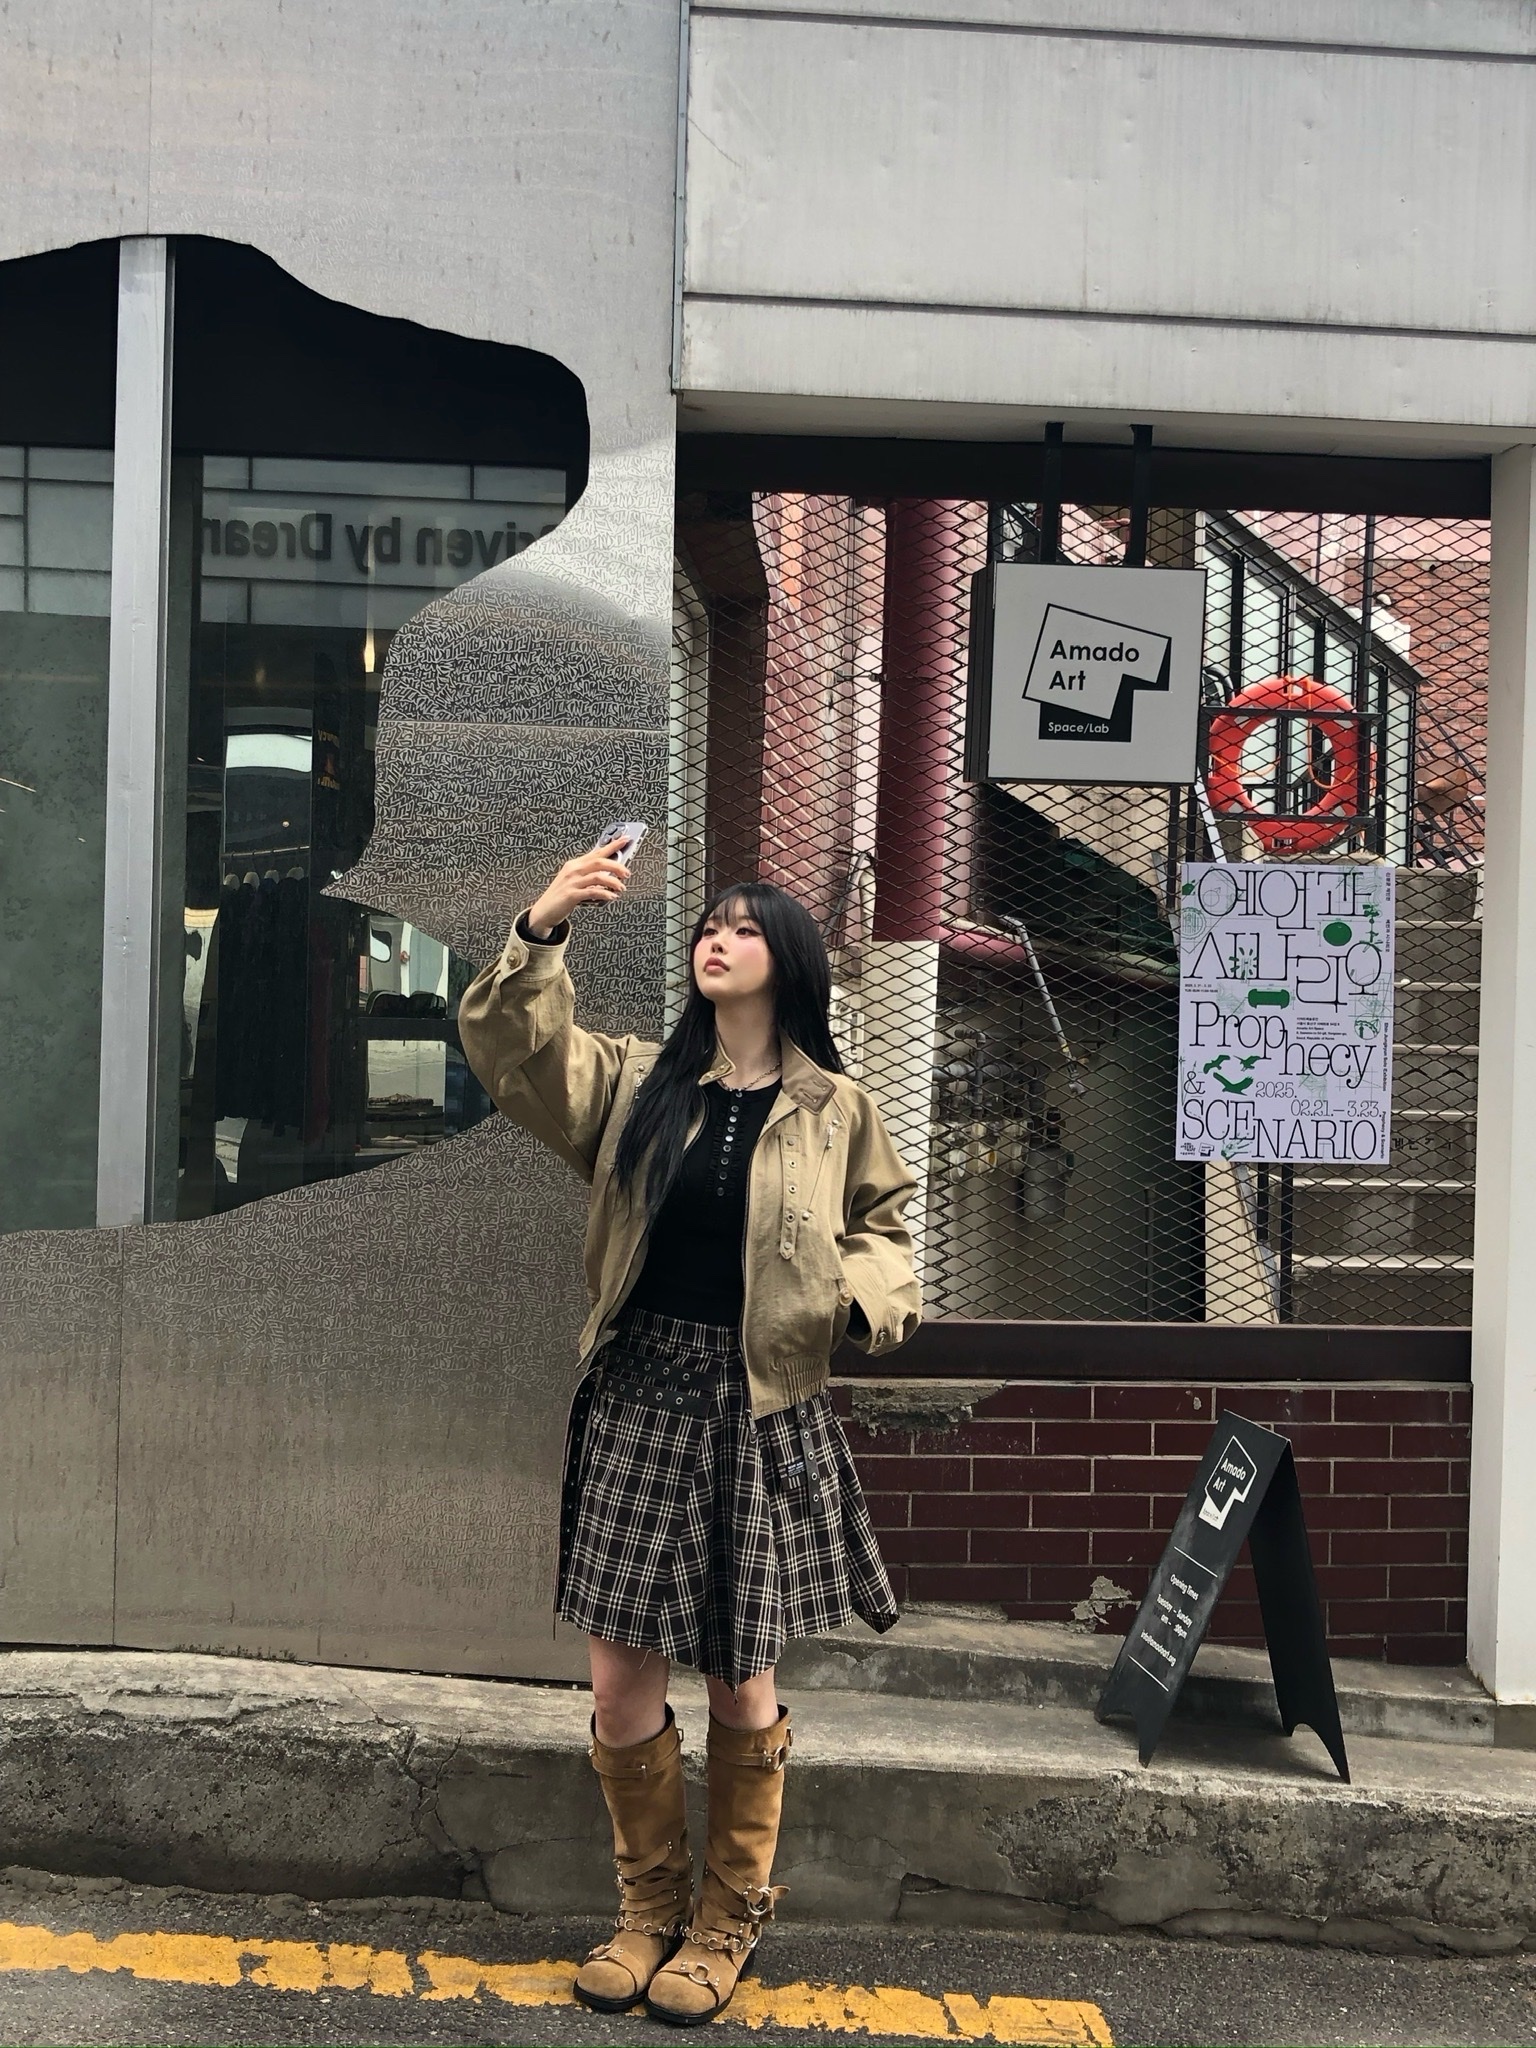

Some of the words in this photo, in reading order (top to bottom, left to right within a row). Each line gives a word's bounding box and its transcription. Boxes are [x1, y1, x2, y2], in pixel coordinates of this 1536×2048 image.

[1049, 639, 1140, 662] Amado
[1048, 670, 1086, 691] Art
[1048, 721, 1110, 734] Space/Lab
[1198, 868, 1372, 929] 예언과
[1183, 932, 1382, 1012] 시나리오
[1189, 1001, 1377, 1089] Prophecy
[1183, 1071, 1206, 1095] &
[1255, 1081, 1298, 1099] 2025.
[1182, 1099, 1377, 1161] SCENARIO
[1221, 1457, 1247, 1481] Amado
[1212, 1476, 1227, 1492] Art
[1170, 1573, 1187, 1595] Opening
[1187, 1584, 1199, 1601] Times
[1156, 1593, 1173, 1613] Tuesday
[1177, 1608, 1193, 1628] Sunday
